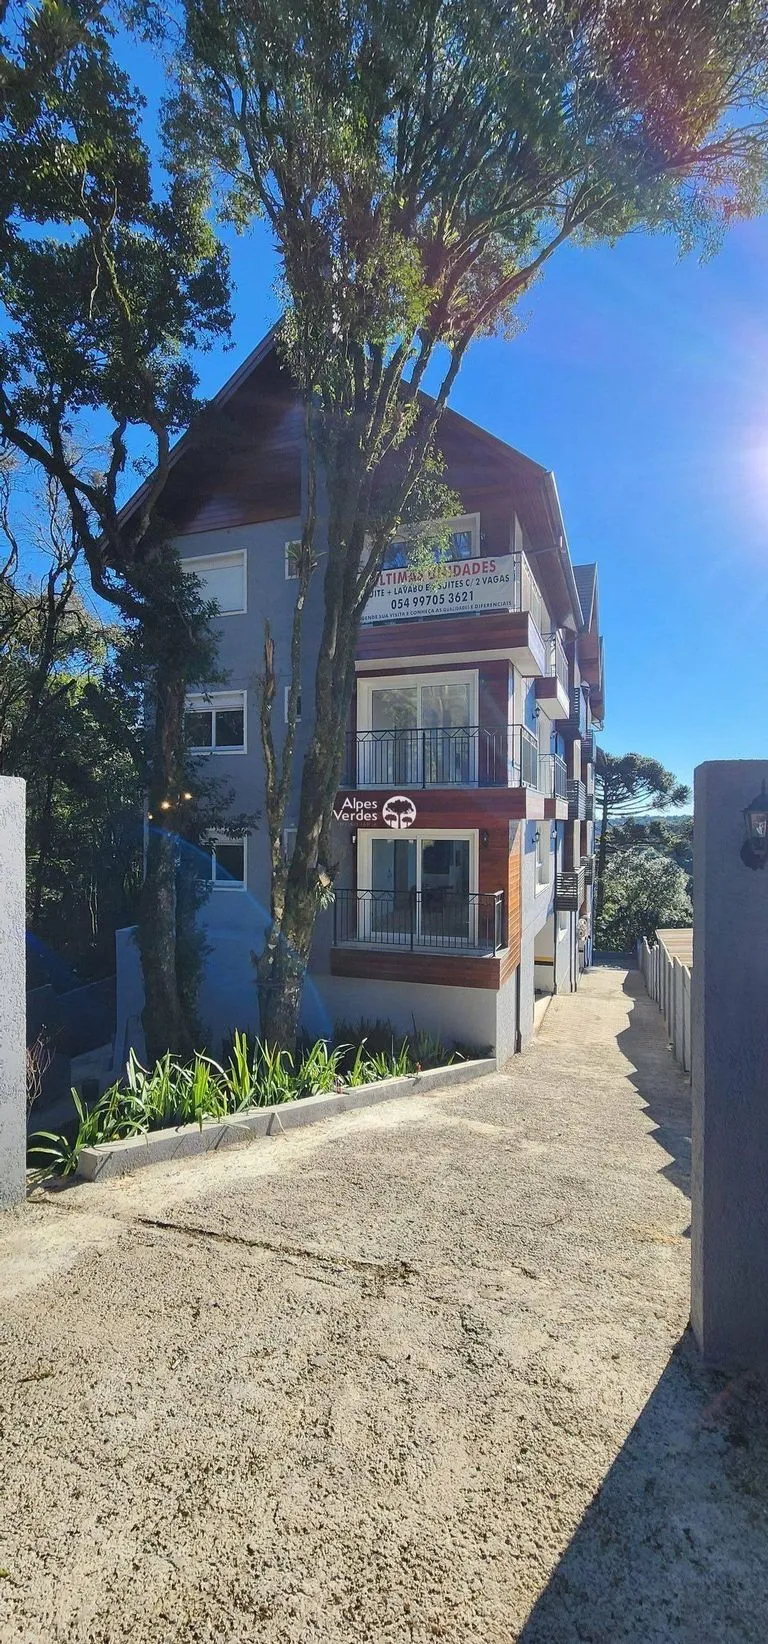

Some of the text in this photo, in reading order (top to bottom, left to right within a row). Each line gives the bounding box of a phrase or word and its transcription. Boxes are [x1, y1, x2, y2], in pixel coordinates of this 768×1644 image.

[377, 570, 425, 586] LTIMAS
[394, 584, 424, 596] LAVABO
[475, 577, 480, 586] 2
[482, 574, 510, 585] VAGAS
[391, 590, 473, 610] 054 99705 3621
